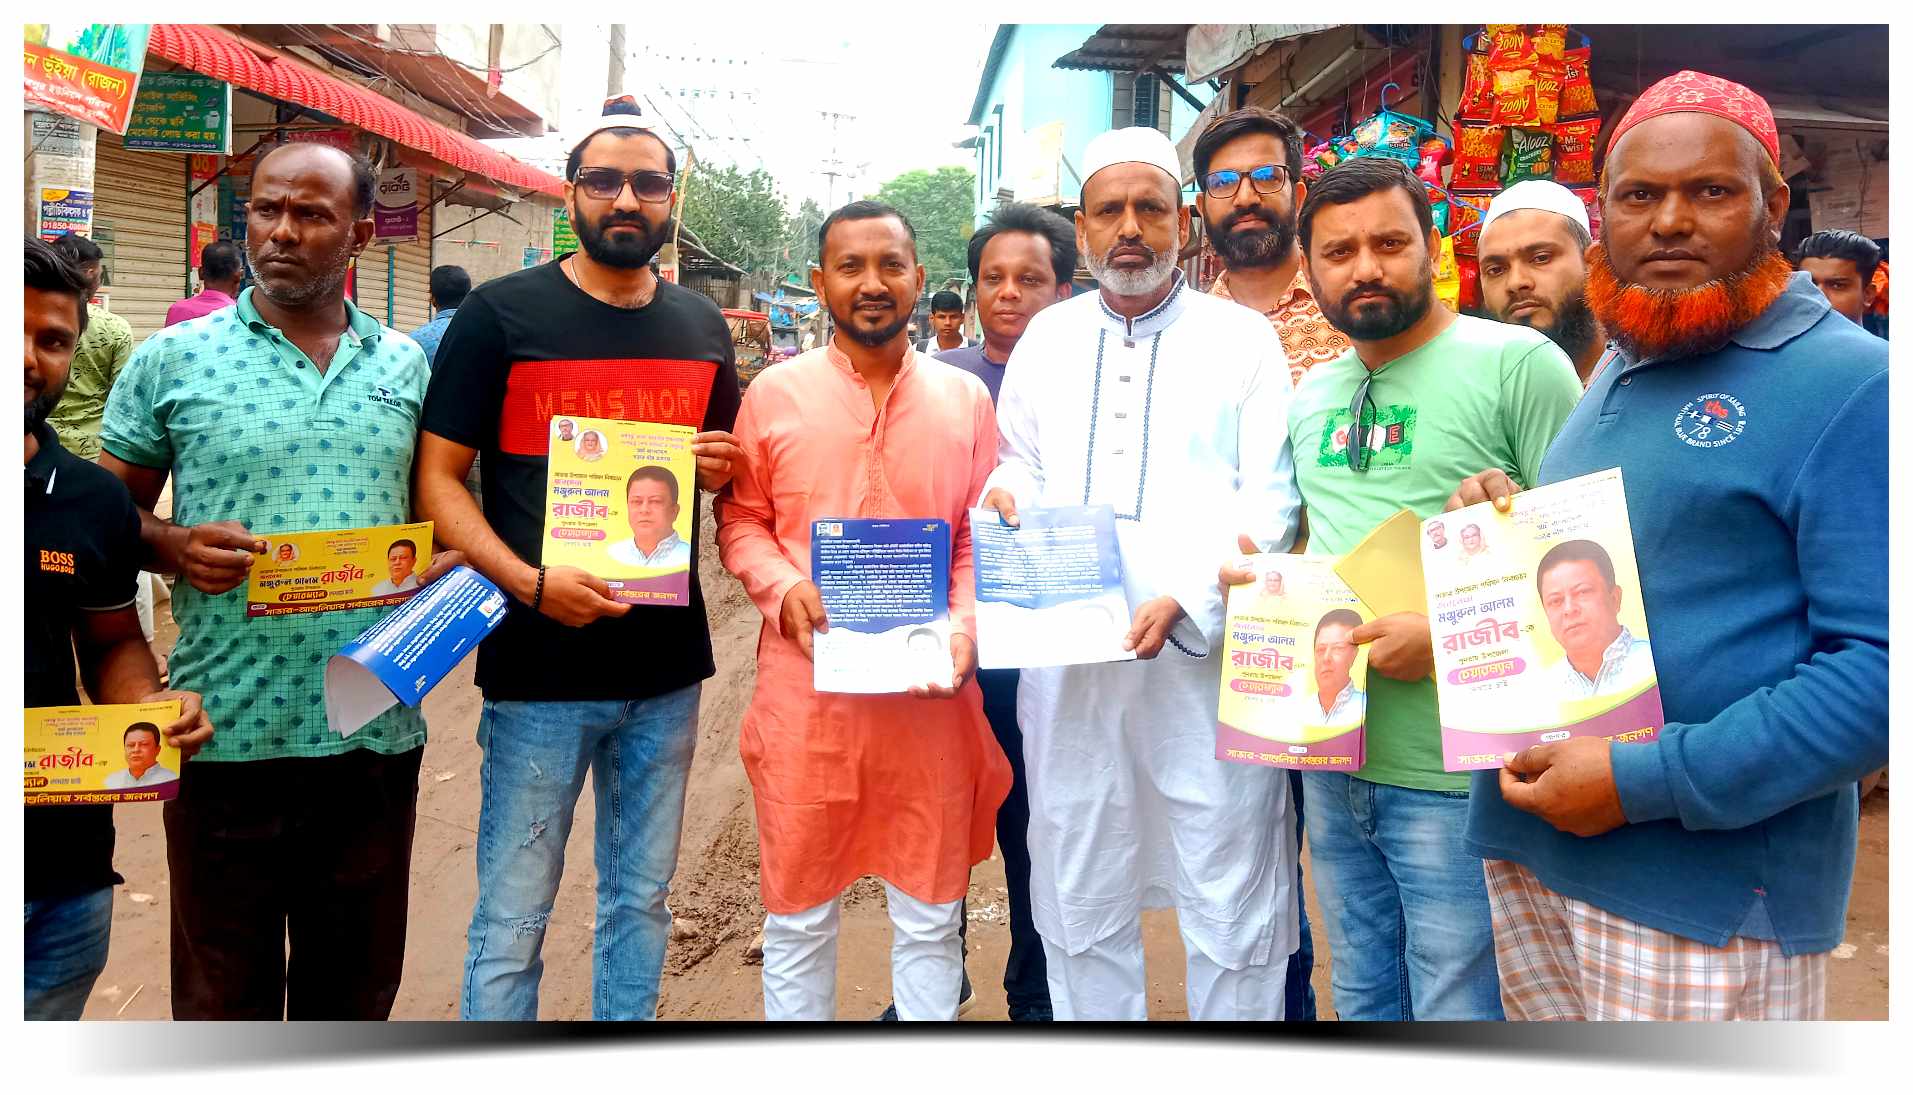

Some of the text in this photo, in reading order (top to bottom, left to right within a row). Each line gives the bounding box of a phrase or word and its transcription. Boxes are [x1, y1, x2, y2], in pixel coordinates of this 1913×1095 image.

[1538, 79, 1559, 92] looz
[1518, 136, 1549, 154] Alooz
[1697, 393, 1719, 403] SPIRIT
[1688, 422, 1711, 439] 78
[1685, 437, 1712, 448] BRAND
[1713, 433, 1736, 448] SINCE
[40, 549, 74, 567] BOSS
[1480, 597, 1515, 614] আলম
